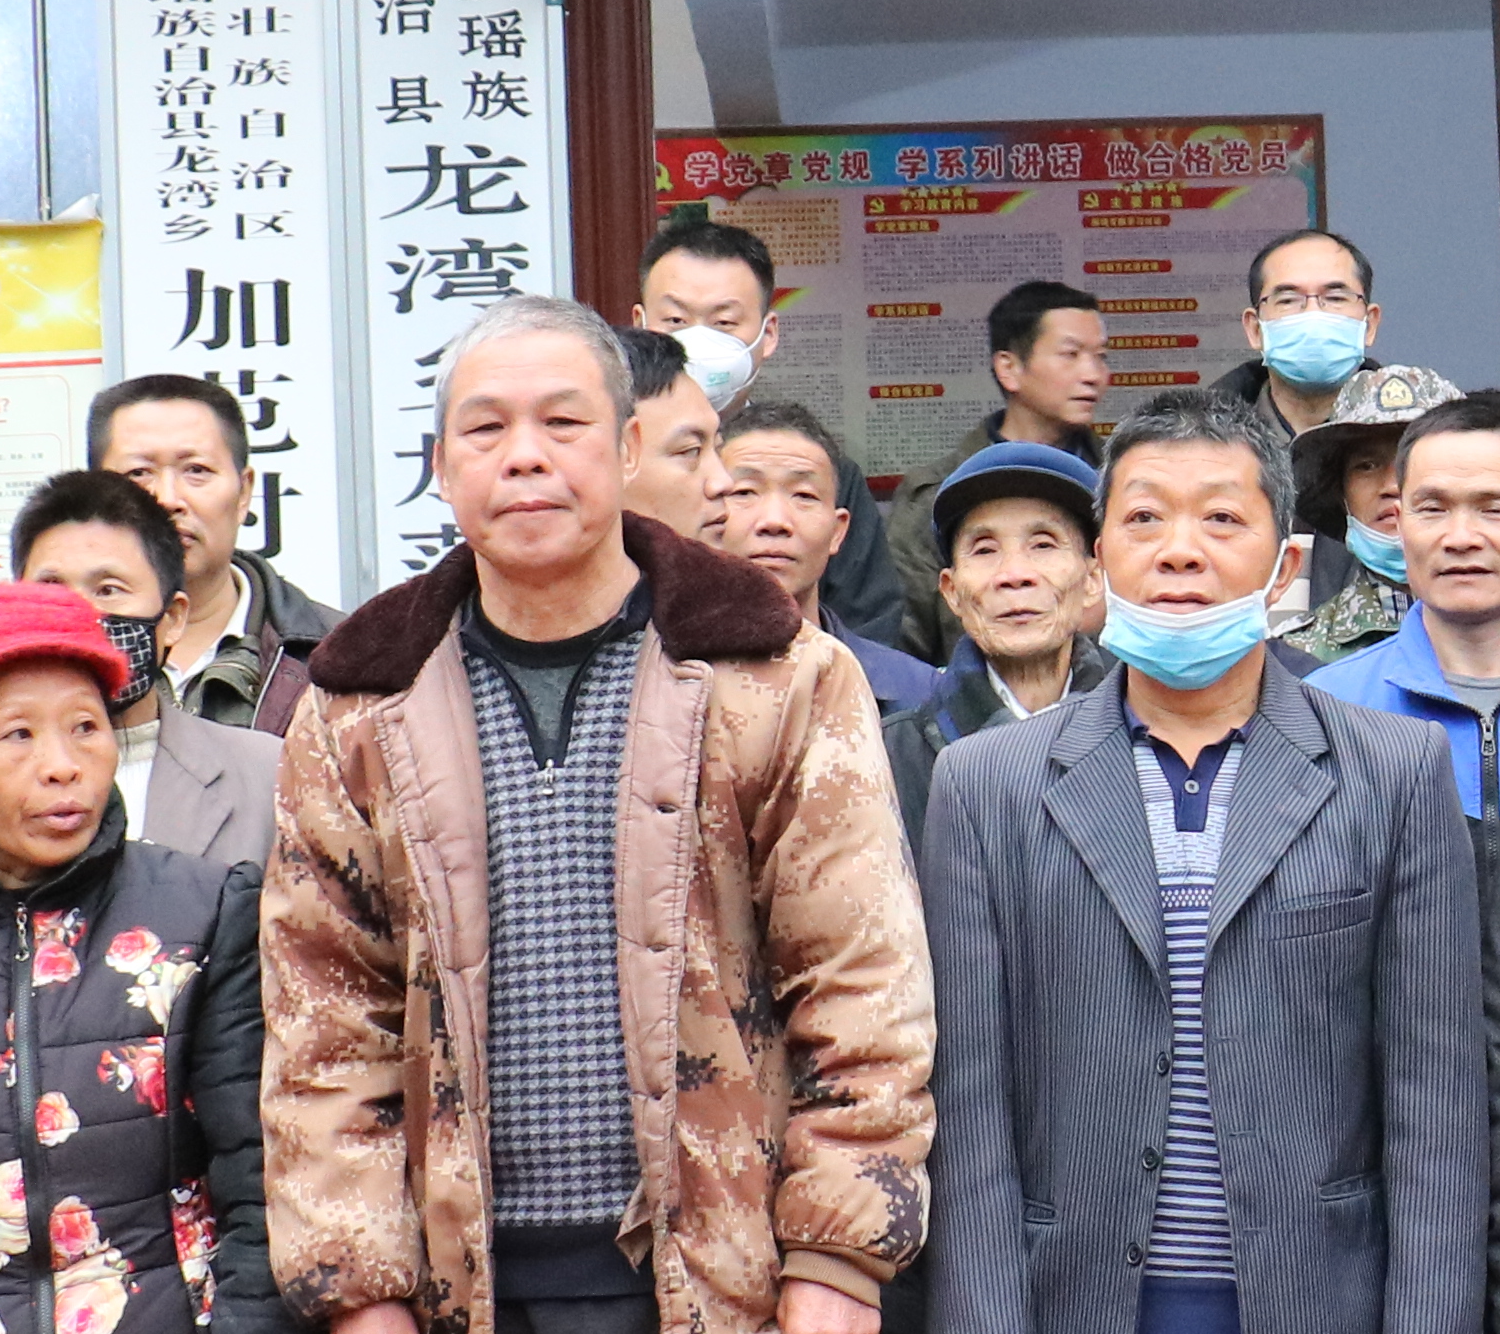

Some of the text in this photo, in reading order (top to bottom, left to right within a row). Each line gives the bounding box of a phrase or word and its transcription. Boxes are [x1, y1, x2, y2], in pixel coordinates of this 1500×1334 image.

[684, 138, 1291, 188] 学党章党规 学系列讲话 做合格党员
